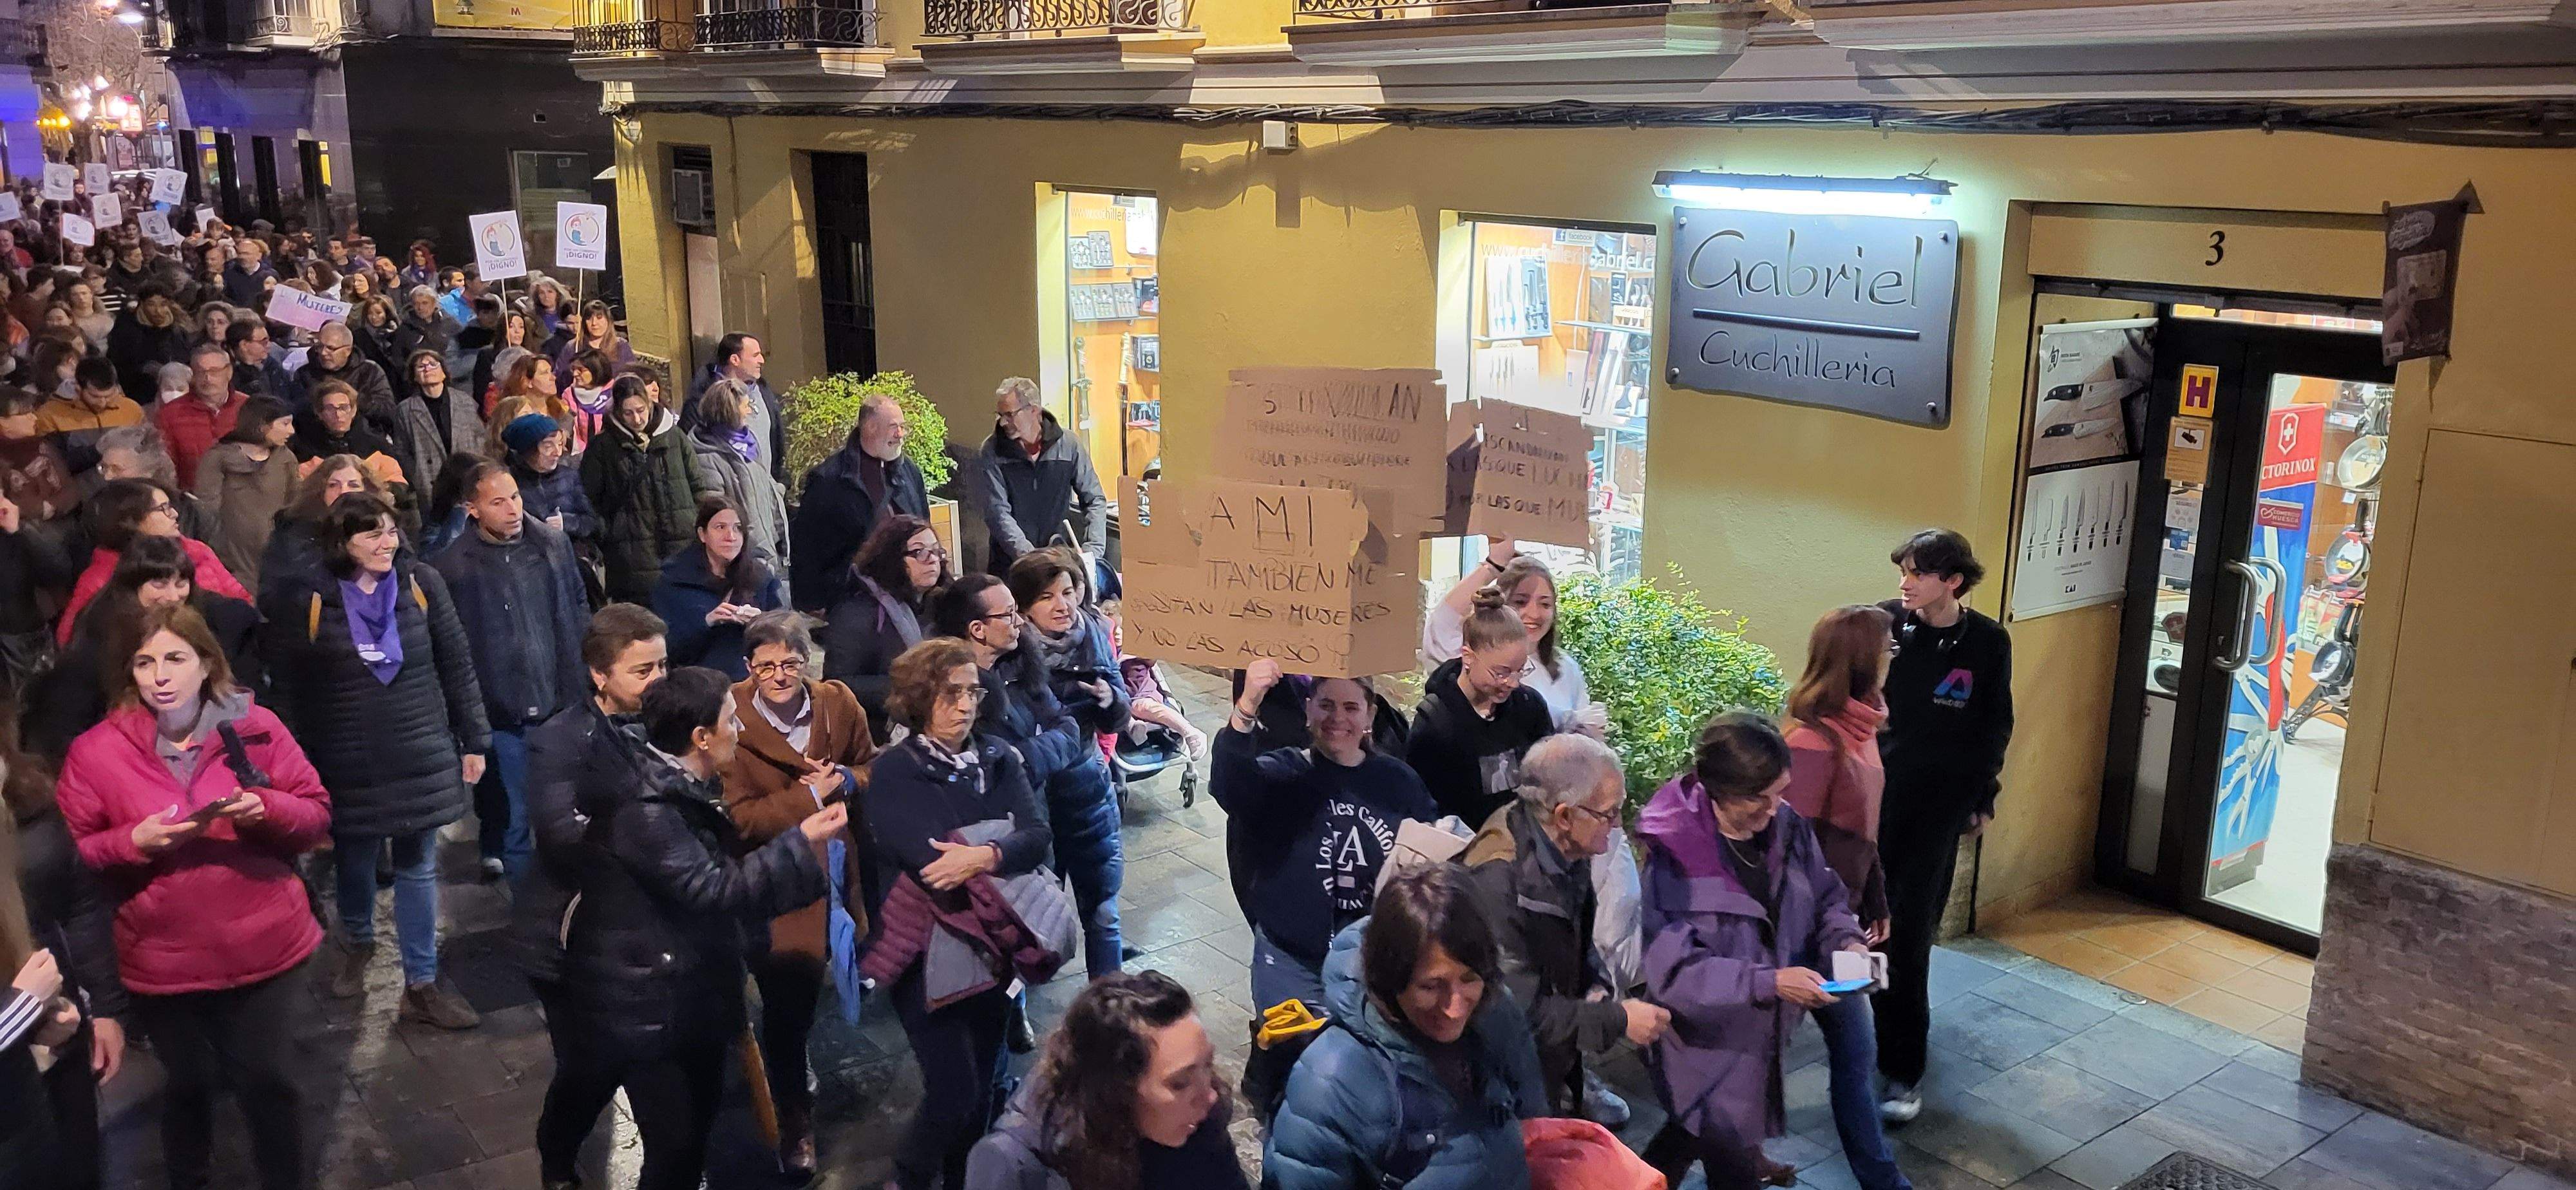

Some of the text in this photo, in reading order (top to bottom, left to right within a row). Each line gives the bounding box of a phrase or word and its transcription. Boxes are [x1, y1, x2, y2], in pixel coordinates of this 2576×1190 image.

[1568, 232, 1593, 241] facebook
[2204, 230, 2226, 267] 3
[488, 260, 517, 272] ¡DIGNO!
[565, 251, 597, 260] ¡DIGNO!
[1686, 228, 1924, 309] Gabriel
[1698, 330, 1896, 389] Cuchilleria
[2185, 374, 2211, 409] H
[1495, 456, 1527, 477] QUE
[1207, 491, 1313, 547] A MI
[1487, 494, 1511, 510] LAS
[1513, 499, 1541, 516] QUE
[1205, 559, 1384, 592] TAMBIEN ME
[2065, 584, 2076, 593] KAI
[1228, 596, 1273, 619] LAS
[1290, 602, 1391, 627] MUJERES
[1132, 619, 1144, 643] Y
[1186, 633, 1224, 653] LAS
[1315, 836, 1333, 870] Los
